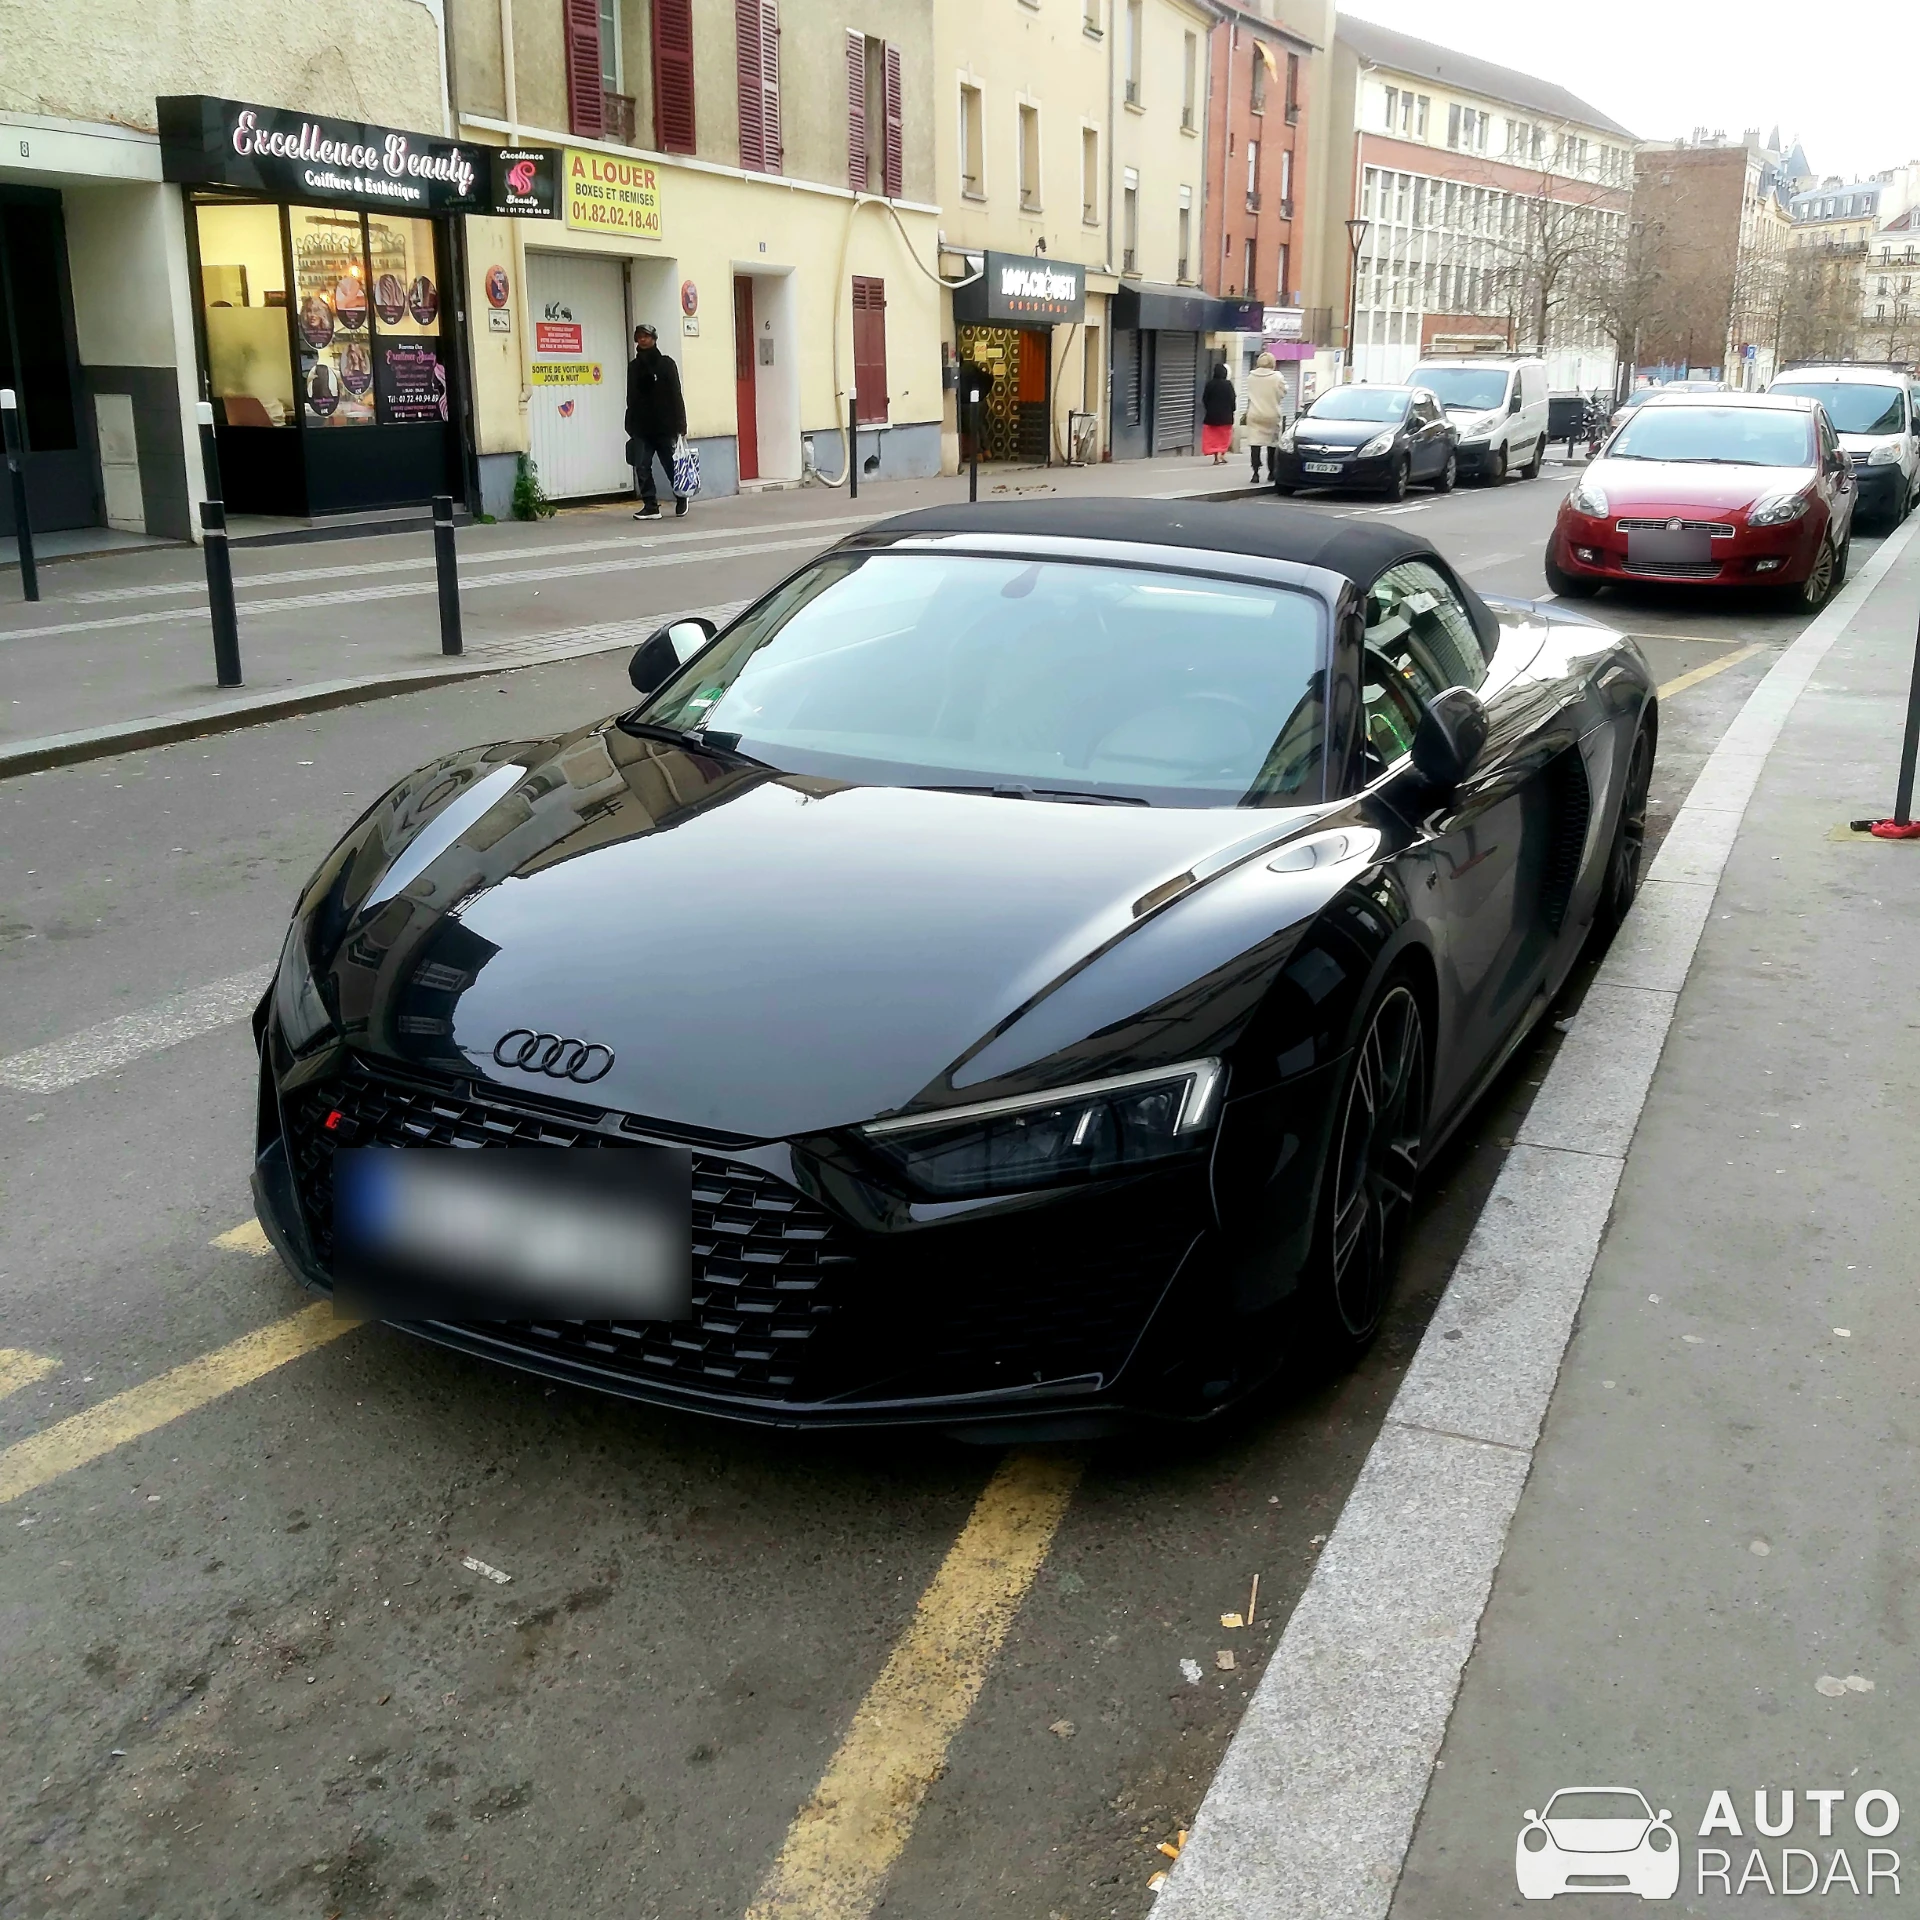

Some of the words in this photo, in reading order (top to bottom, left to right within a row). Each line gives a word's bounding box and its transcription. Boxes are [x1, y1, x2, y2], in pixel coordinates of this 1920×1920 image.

[21, 142, 28, 157] 8
[233, 110, 379, 168] Excellence
[382, 133, 475, 196] Beauty
[500, 151, 544, 160] Excellence
[572, 156, 586, 179] A
[592, 159, 656, 190] LOUER
[304, 169, 352, 190] Coiffure
[354, 177, 364, 191] &
[365, 177, 420, 201] Esthétique
[506, 195, 539, 207] Beauty
[575, 182, 604, 198] BOXES
[606, 188, 616, 200] ET
[619, 190, 655, 207] REMISES
[572, 201, 659, 231] 01.82.02.18.40
[765, 320, 771, 331] 6
[532, 365, 552, 374] SORTIE
[554, 366, 561, 374] DE
[562, 365, 590, 374] VOITURES
[544, 374, 559, 382] JOUR
[566, 374, 579, 382] NUIT
